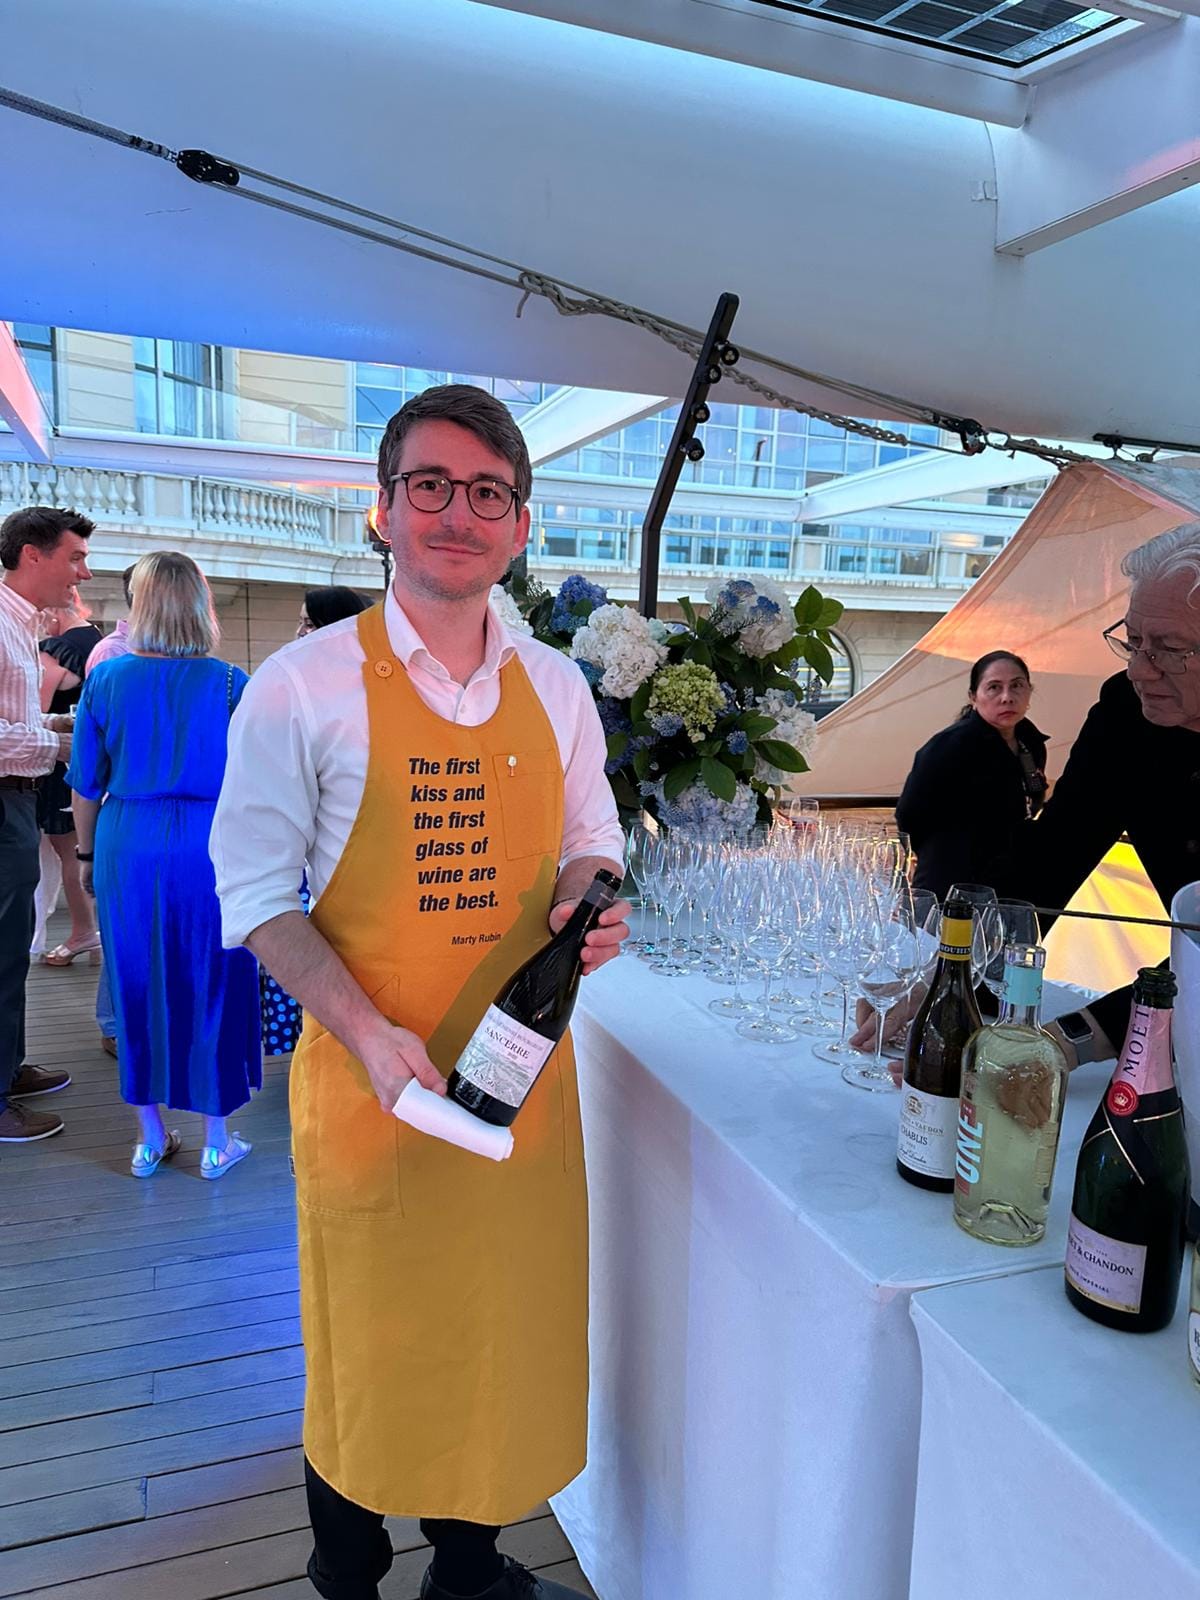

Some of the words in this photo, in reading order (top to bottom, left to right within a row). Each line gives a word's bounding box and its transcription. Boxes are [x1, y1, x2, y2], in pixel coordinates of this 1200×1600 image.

[409, 757, 440, 775] The
[446, 757, 480, 775] first
[410, 785, 447, 802] kiss
[453, 784, 485, 801] and
[414, 812, 443, 829] the
[448, 811, 485, 829] first
[415, 839, 465, 861] glass
[471, 837, 489, 854] of
[418, 867, 463, 884] wine
[469, 866, 497, 883] are
[419, 895, 449, 912] the
[456, 891, 499, 910] best.
[451, 937, 477, 946] Marty
[478, 933, 502, 943] Rubin
[484, 1026, 530, 1059] SANCERRE
[901, 1123, 928, 1146] CHABLIS
[956, 1116, 983, 1184] ONE
[1084, 1252, 1135, 1276] CHANDON
